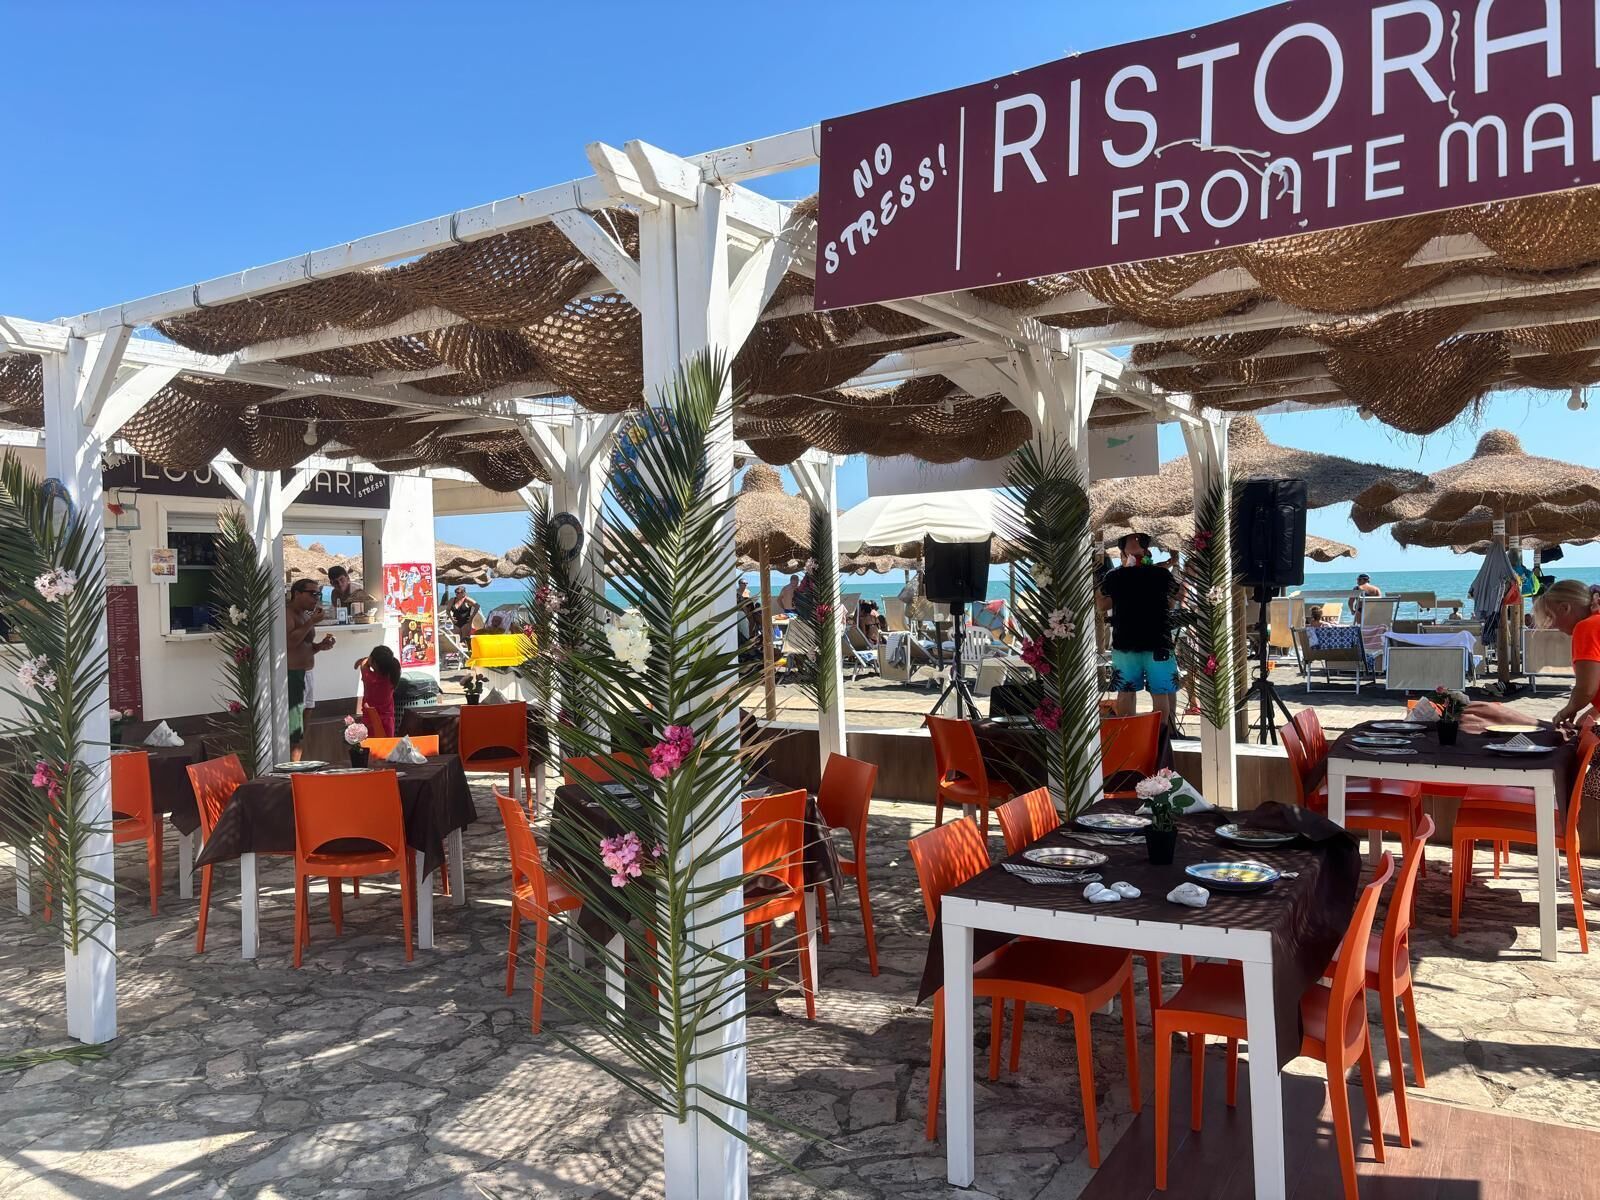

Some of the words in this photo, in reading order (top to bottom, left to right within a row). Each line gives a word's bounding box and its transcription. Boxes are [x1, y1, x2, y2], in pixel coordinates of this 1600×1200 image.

[993, 0, 1600, 193] RISTORA
[824, 143, 948, 274] STRESS!
[852, 142, 893, 198] NO
[1111, 134, 1404, 245] FRONTE
[1438, 95, 1600, 188] MA
[358, 477, 386, 498] STRESS!
[363, 474, 374, 485] NO
